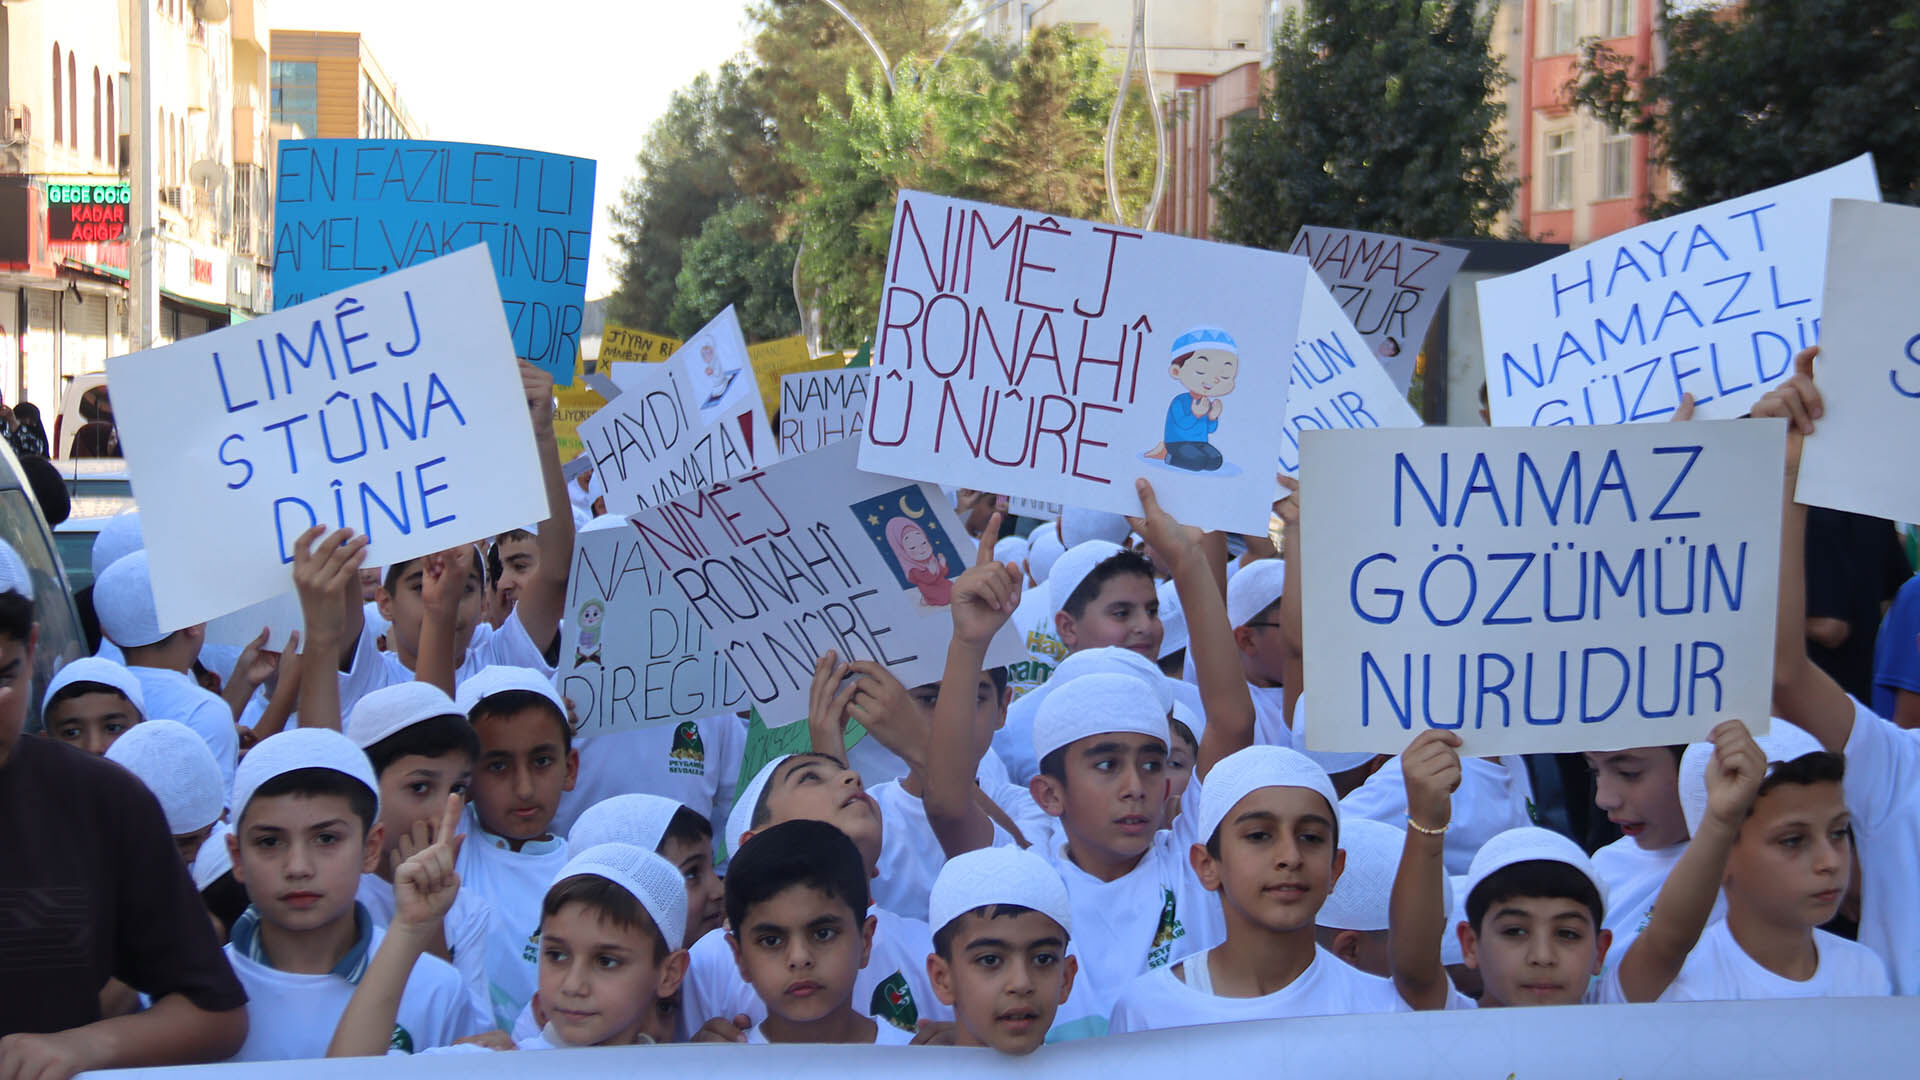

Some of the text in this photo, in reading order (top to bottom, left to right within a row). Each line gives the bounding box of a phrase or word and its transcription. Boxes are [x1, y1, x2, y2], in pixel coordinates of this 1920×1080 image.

[71, 204, 124, 223] KADAR
[278, 147, 338, 203] EN
[892, 199, 1143, 318] NIMÊJ
[1292, 231, 1441, 292] NAMAZ
[1552, 202, 1777, 319] HAYAT
[213, 290, 421, 413] LIMÊJ
[784, 373, 871, 415] NAMA
[879, 286, 1152, 404] RONAHÎ
[1530, 316, 1821, 428] GÜZELDİ
[218, 372, 467, 490] STÛNA
[586, 372, 690, 493] HAYDİ
[934, 379, 1124, 485] NÛRE
[274, 456, 457, 565] DÎNE
[631, 471, 791, 571] NIMÊJ
[1394, 446, 1704, 528] NAMAZ
[672, 521, 861, 630] RONAHÎ
[1350, 535, 1748, 627] GÖZÜMÜN
[1361, 640, 1725, 730] NURUDUR
